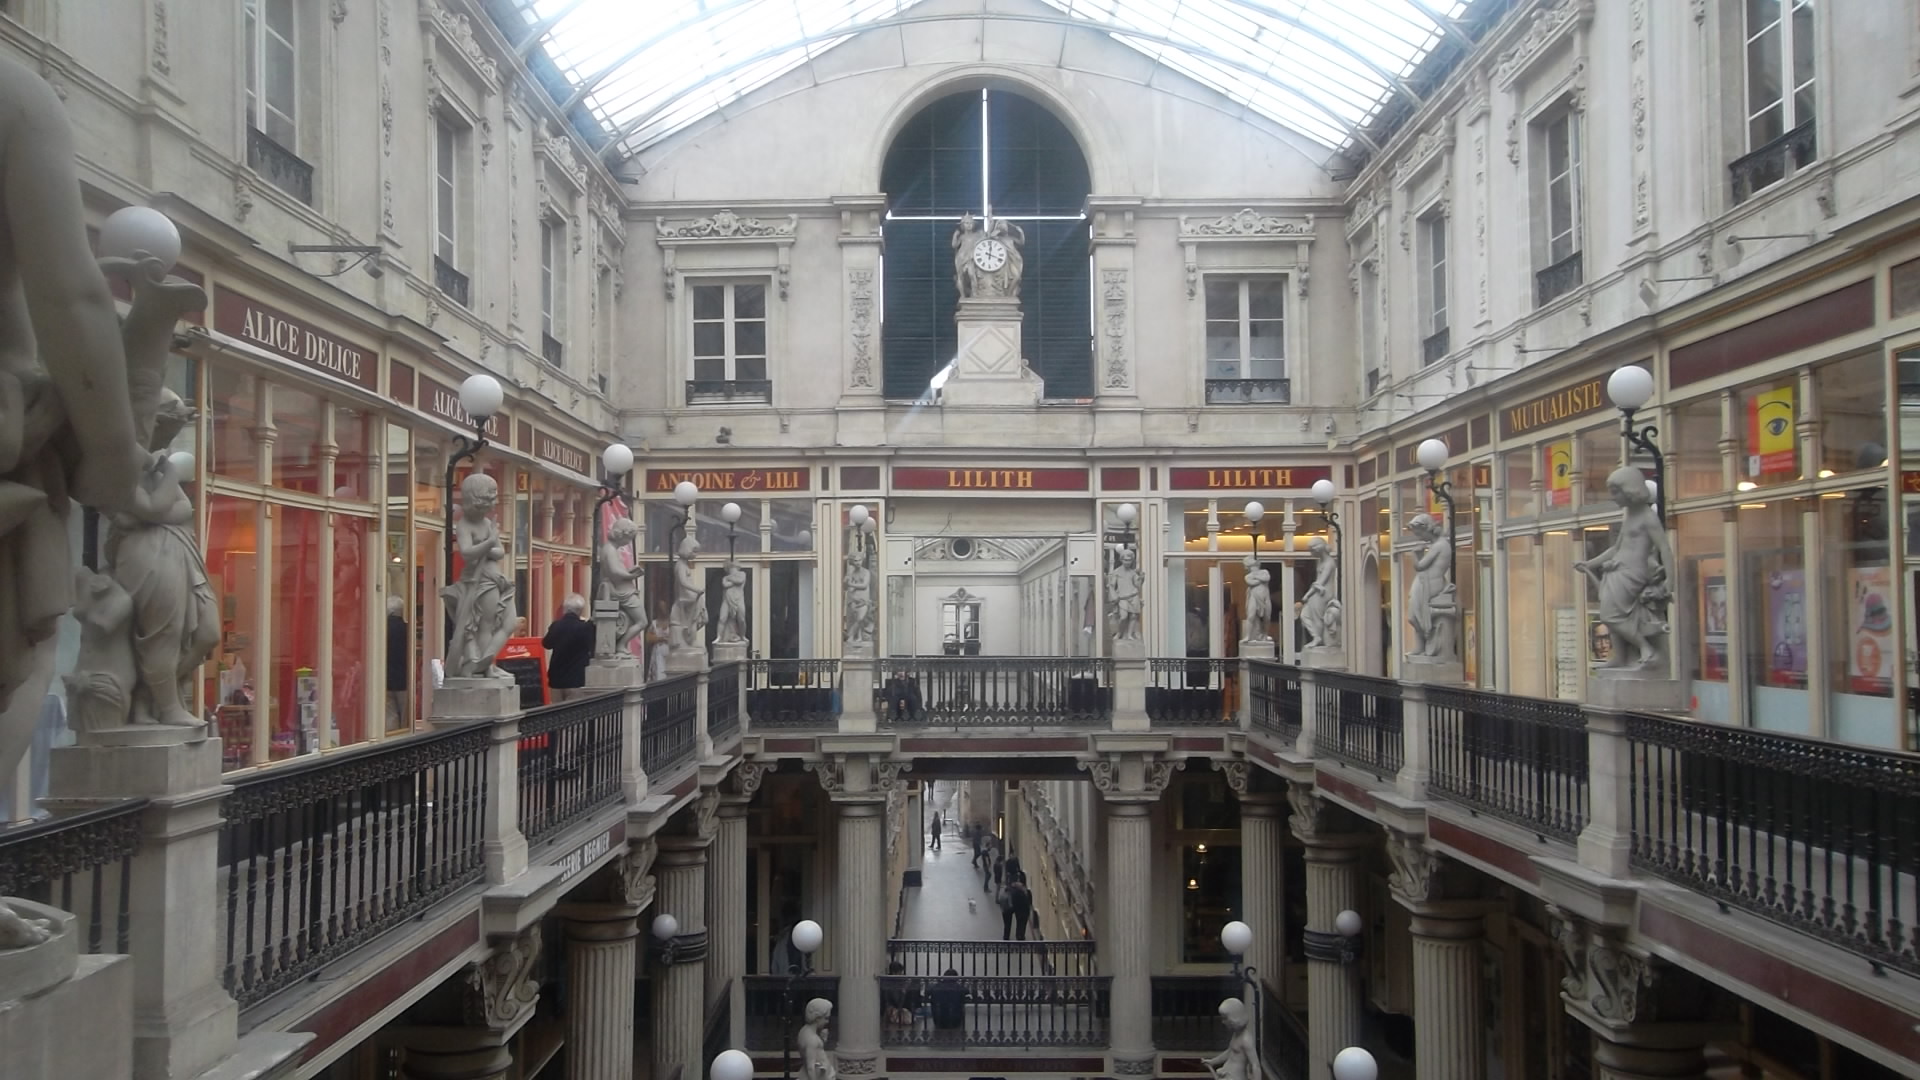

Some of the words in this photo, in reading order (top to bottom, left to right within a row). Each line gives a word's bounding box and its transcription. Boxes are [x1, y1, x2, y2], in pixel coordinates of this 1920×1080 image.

[242, 307, 299, 355] ALICE
[304, 331, 361, 380] DELICE
[433, 389, 463, 422] ALICE
[1511, 381, 1602, 433] MUTUALISTE
[542, 438, 561, 463] ALICE
[562, 447, 583, 472] DELICE
[657, 472, 735, 490] ANTOINE
[740, 470, 761, 490] &
[765, 472, 799, 488] LILI
[948, 470, 1033, 488] LILITH
[1208, 469, 1293, 487] LILITH
